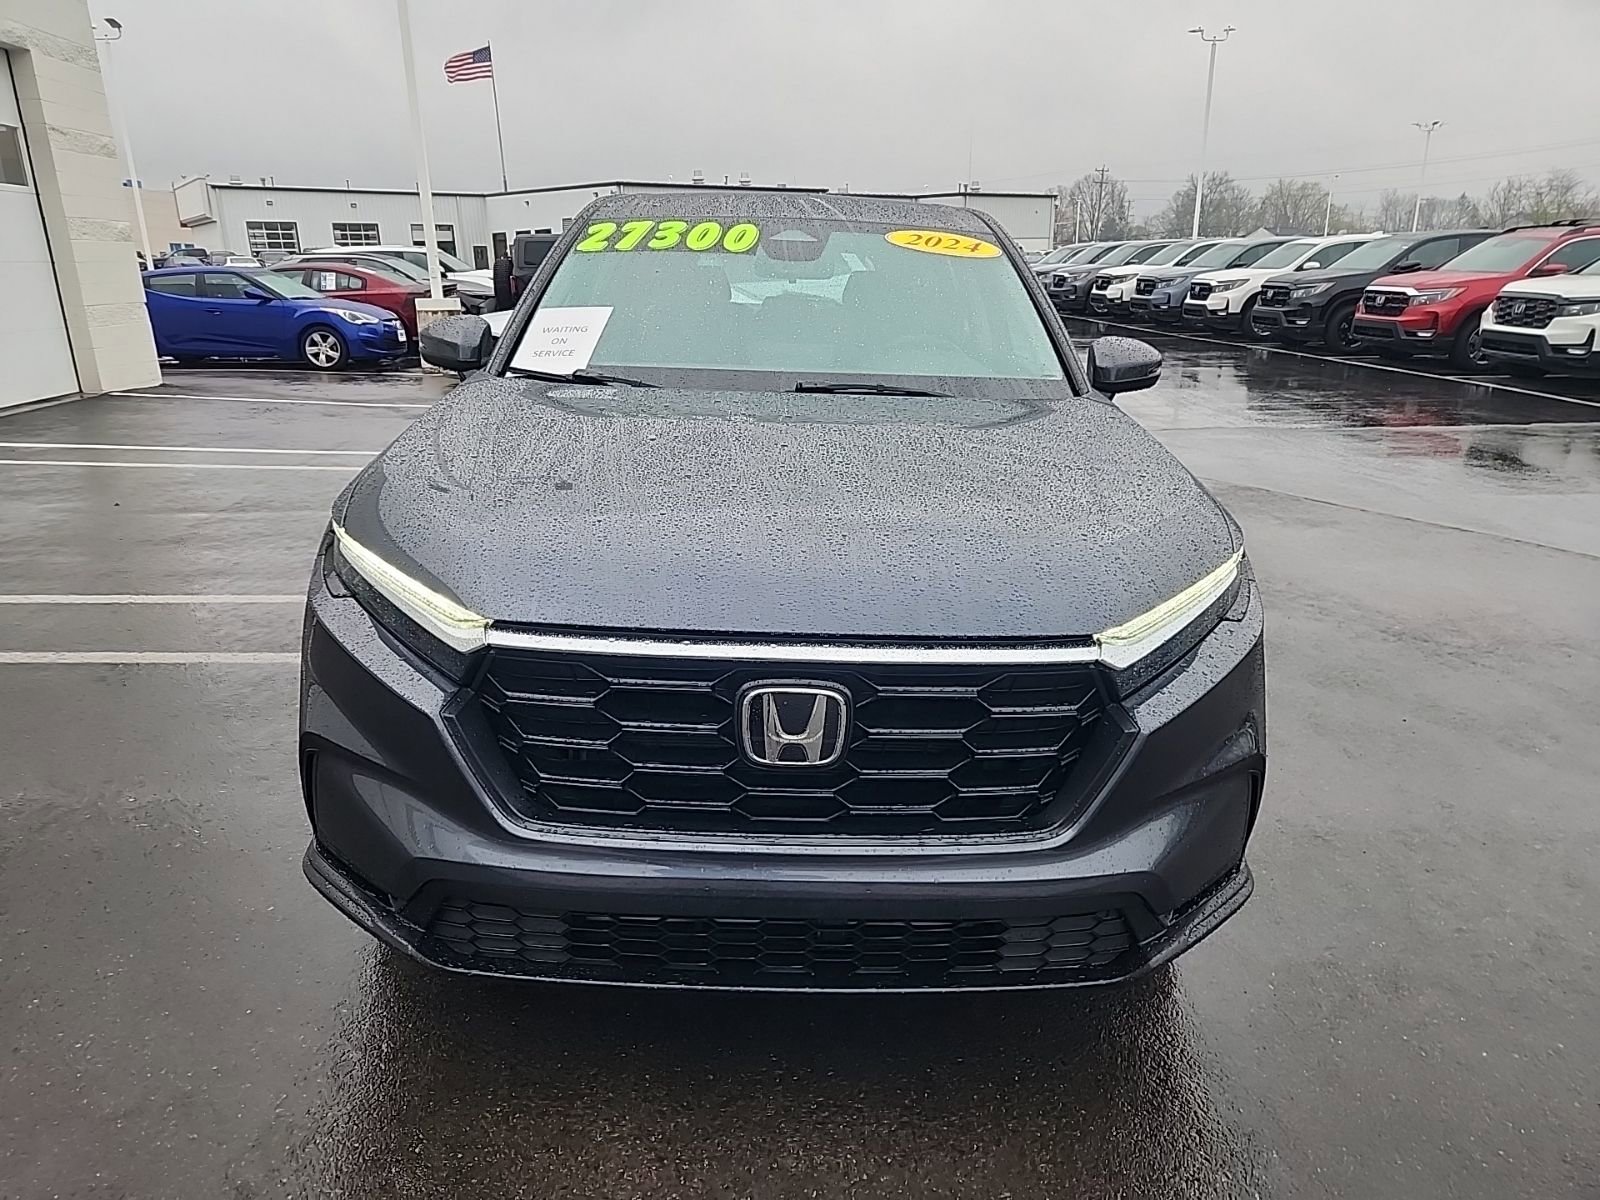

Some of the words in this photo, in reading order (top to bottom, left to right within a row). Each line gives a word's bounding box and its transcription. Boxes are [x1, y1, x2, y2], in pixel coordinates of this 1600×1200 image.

[576, 220, 760, 253] 27300
[903, 233, 983, 253] 2024
[542, 325, 588, 334] WAITING
[551, 337, 568, 345] ON
[531, 349, 576, 358] SERVICE
